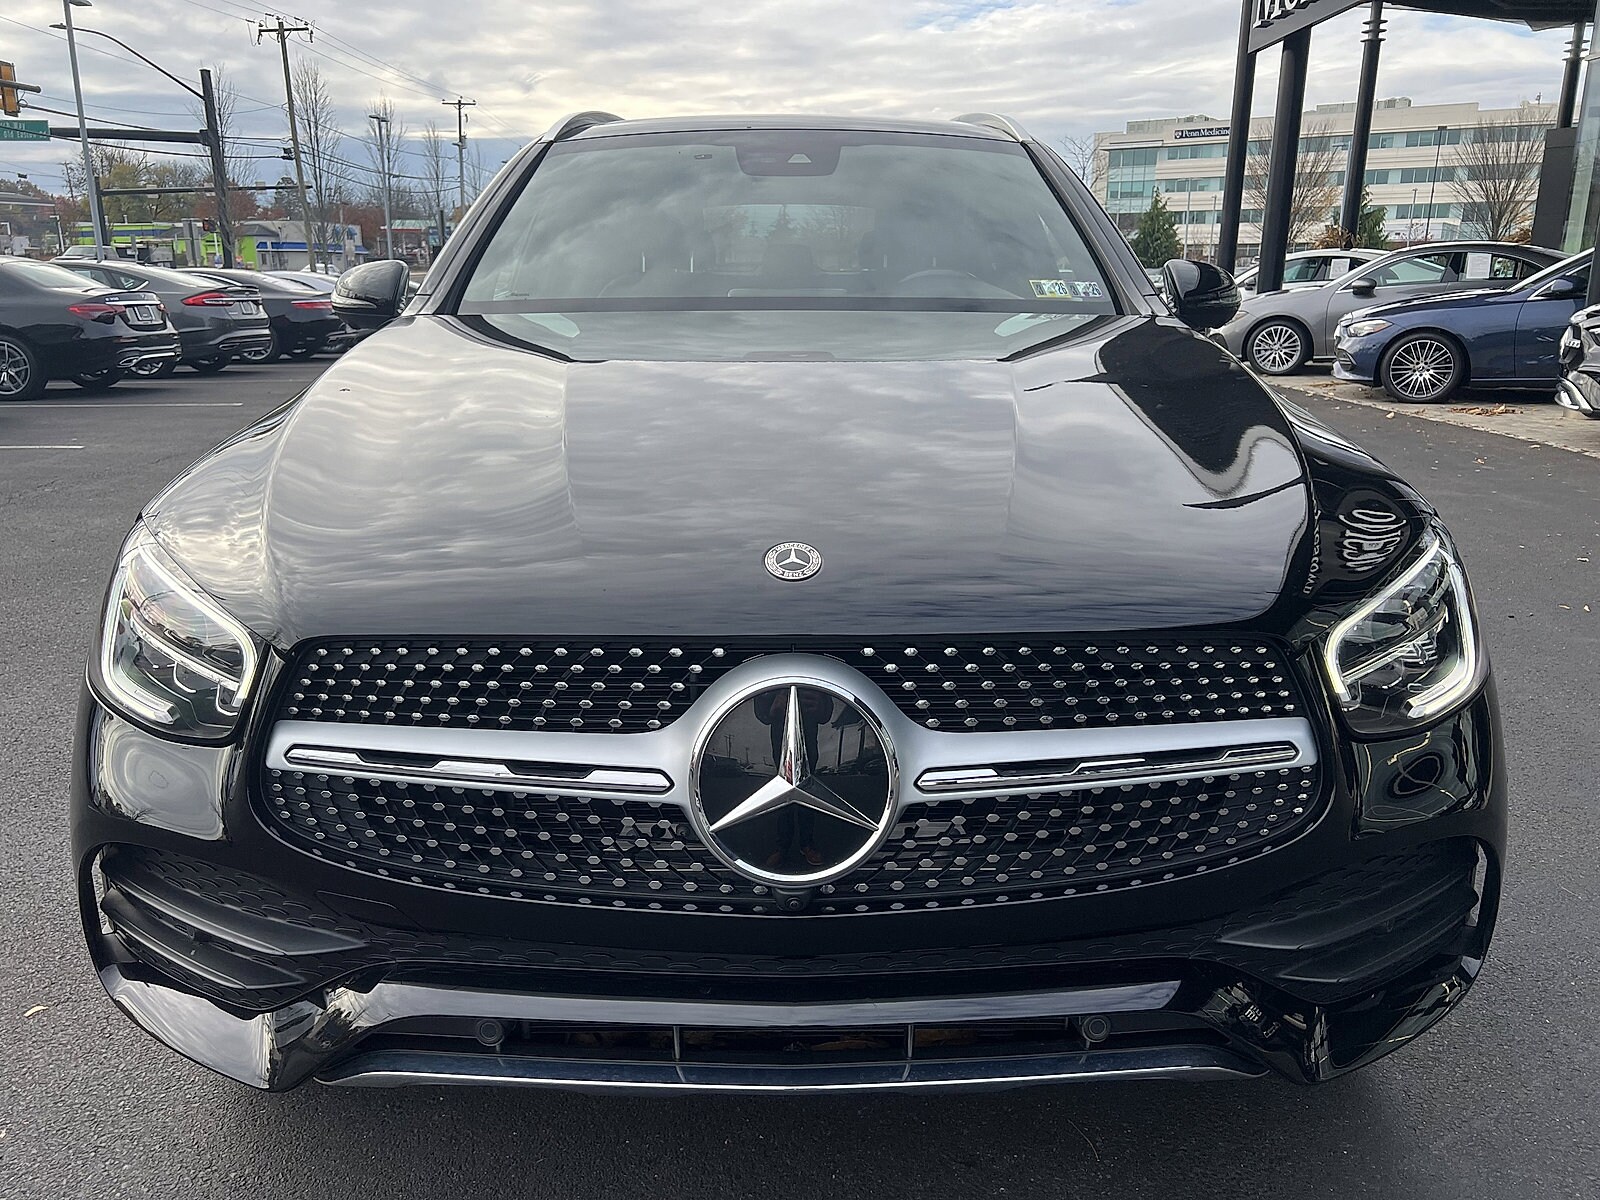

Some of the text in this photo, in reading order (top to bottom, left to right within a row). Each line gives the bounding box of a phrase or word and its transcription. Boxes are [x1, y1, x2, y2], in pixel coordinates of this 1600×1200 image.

[1182, 130, 1200, 138] Penn
[1054, 282, 1068, 295] 26
[1088, 283, 1102, 296] 26
